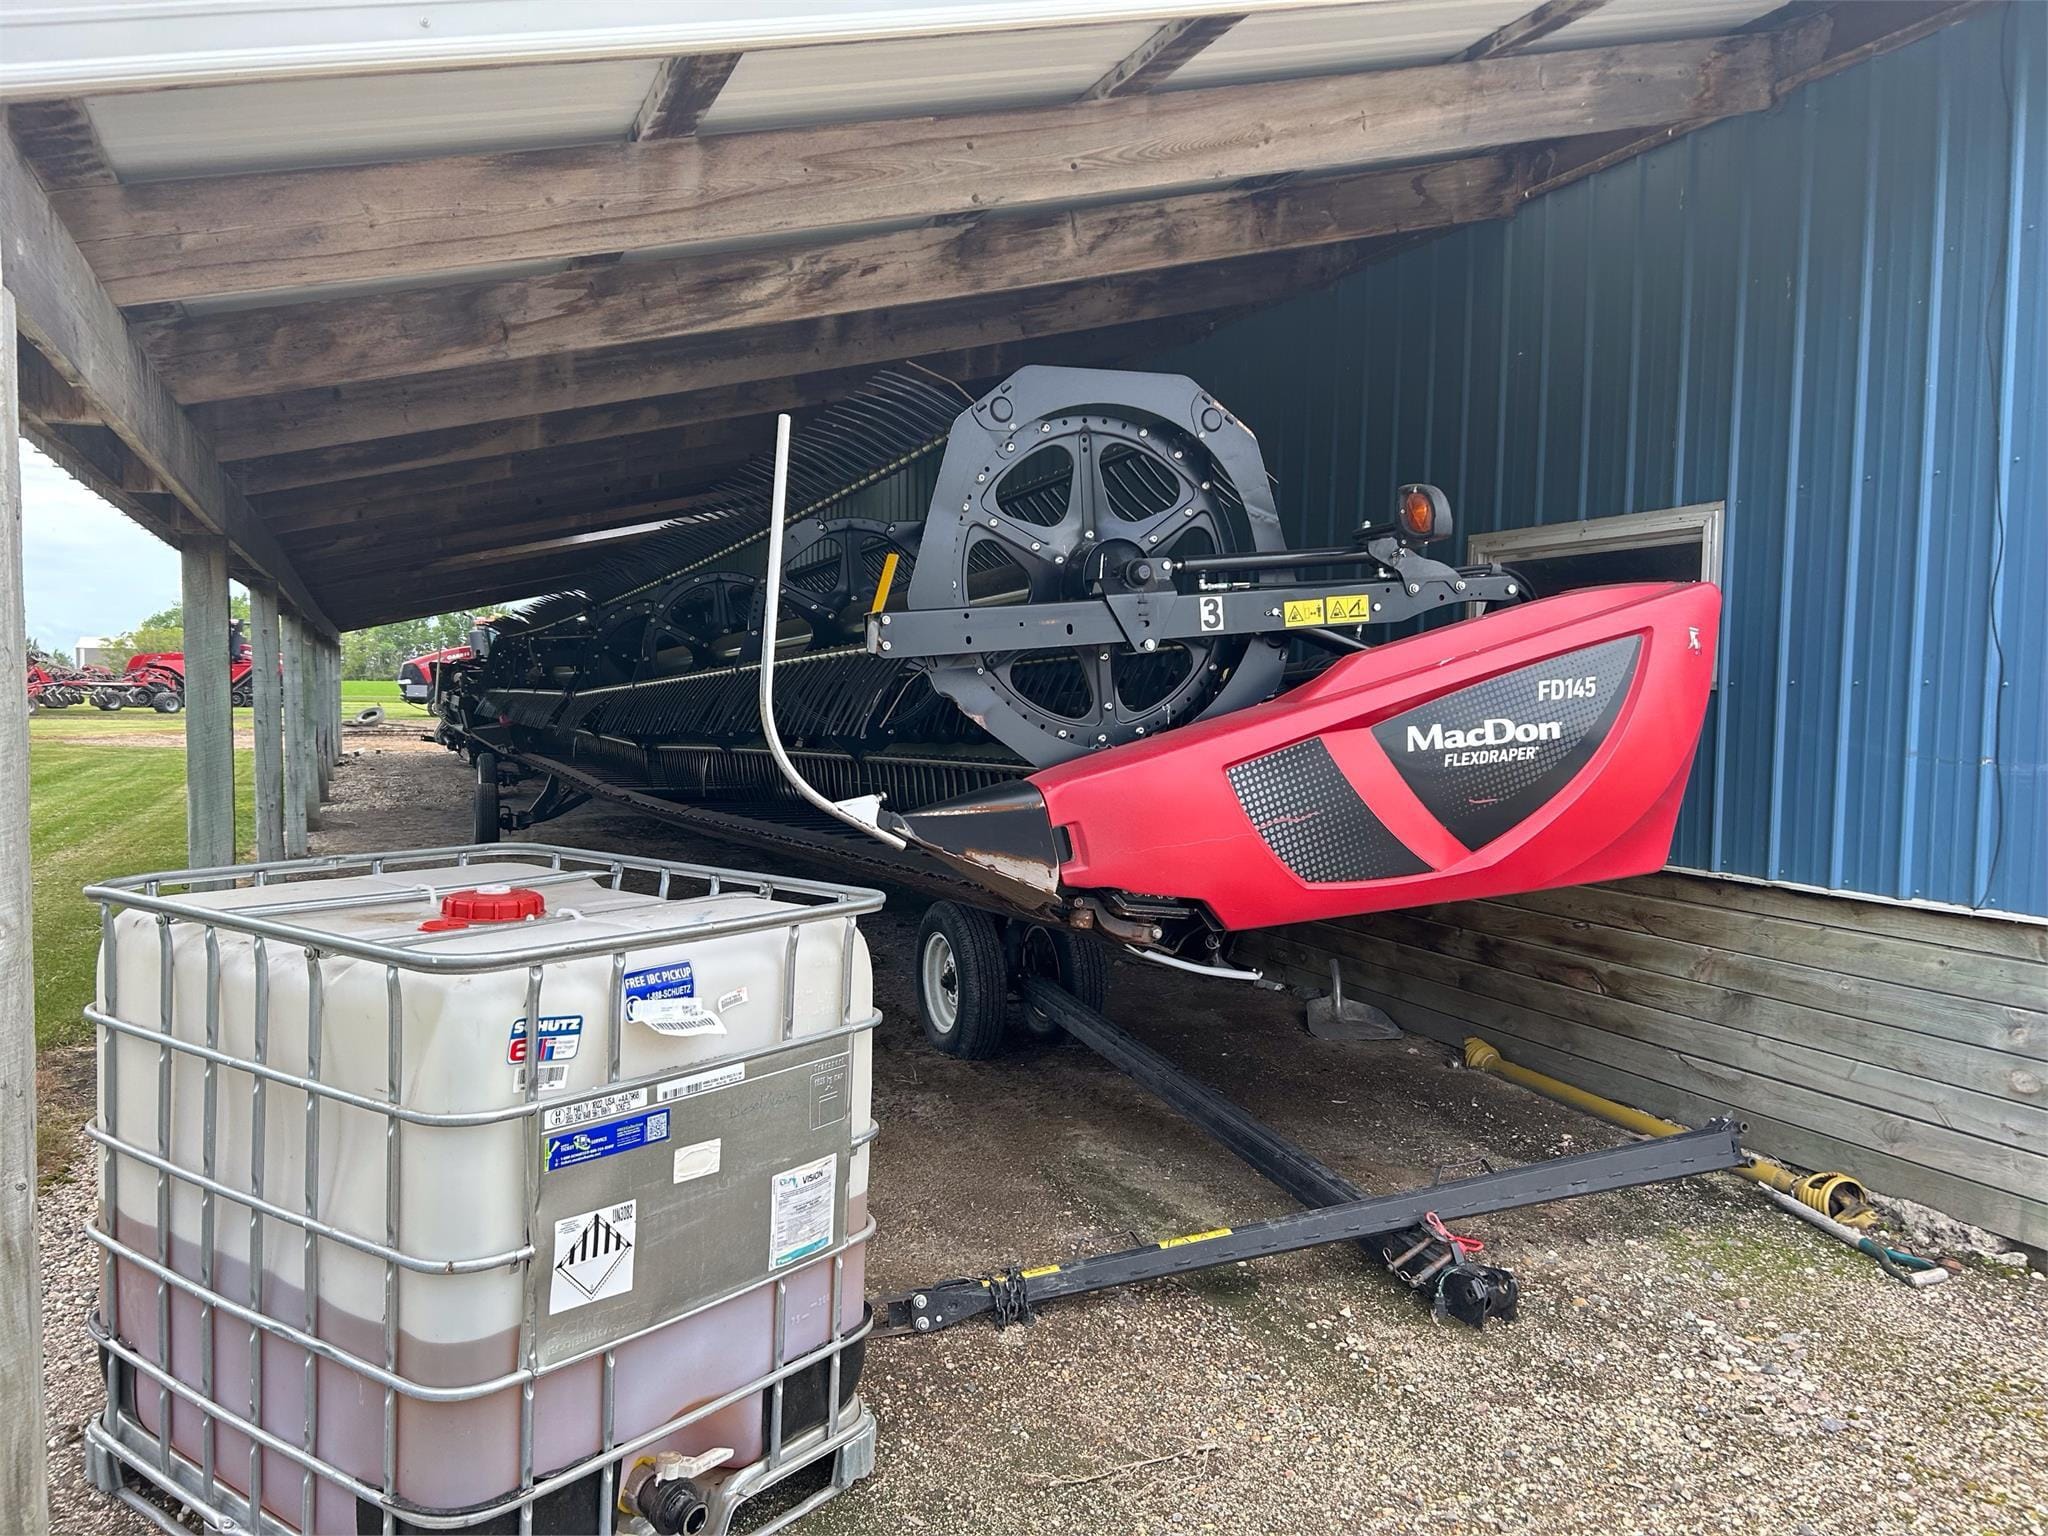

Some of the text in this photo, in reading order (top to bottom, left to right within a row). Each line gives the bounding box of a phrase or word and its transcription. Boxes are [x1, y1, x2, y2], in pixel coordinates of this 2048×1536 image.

[1203, 598, 1221, 629] 3
[1538, 676, 1597, 701] FD145
[1407, 718, 1563, 752] MacDon
[1444, 747, 1536, 768] FLEXDRAPER
[625, 966, 691, 989] FREE IBC PICKUP
[513, 1018, 581, 1034] SHUTZ
[612, 1204, 633, 1224] UN3082
